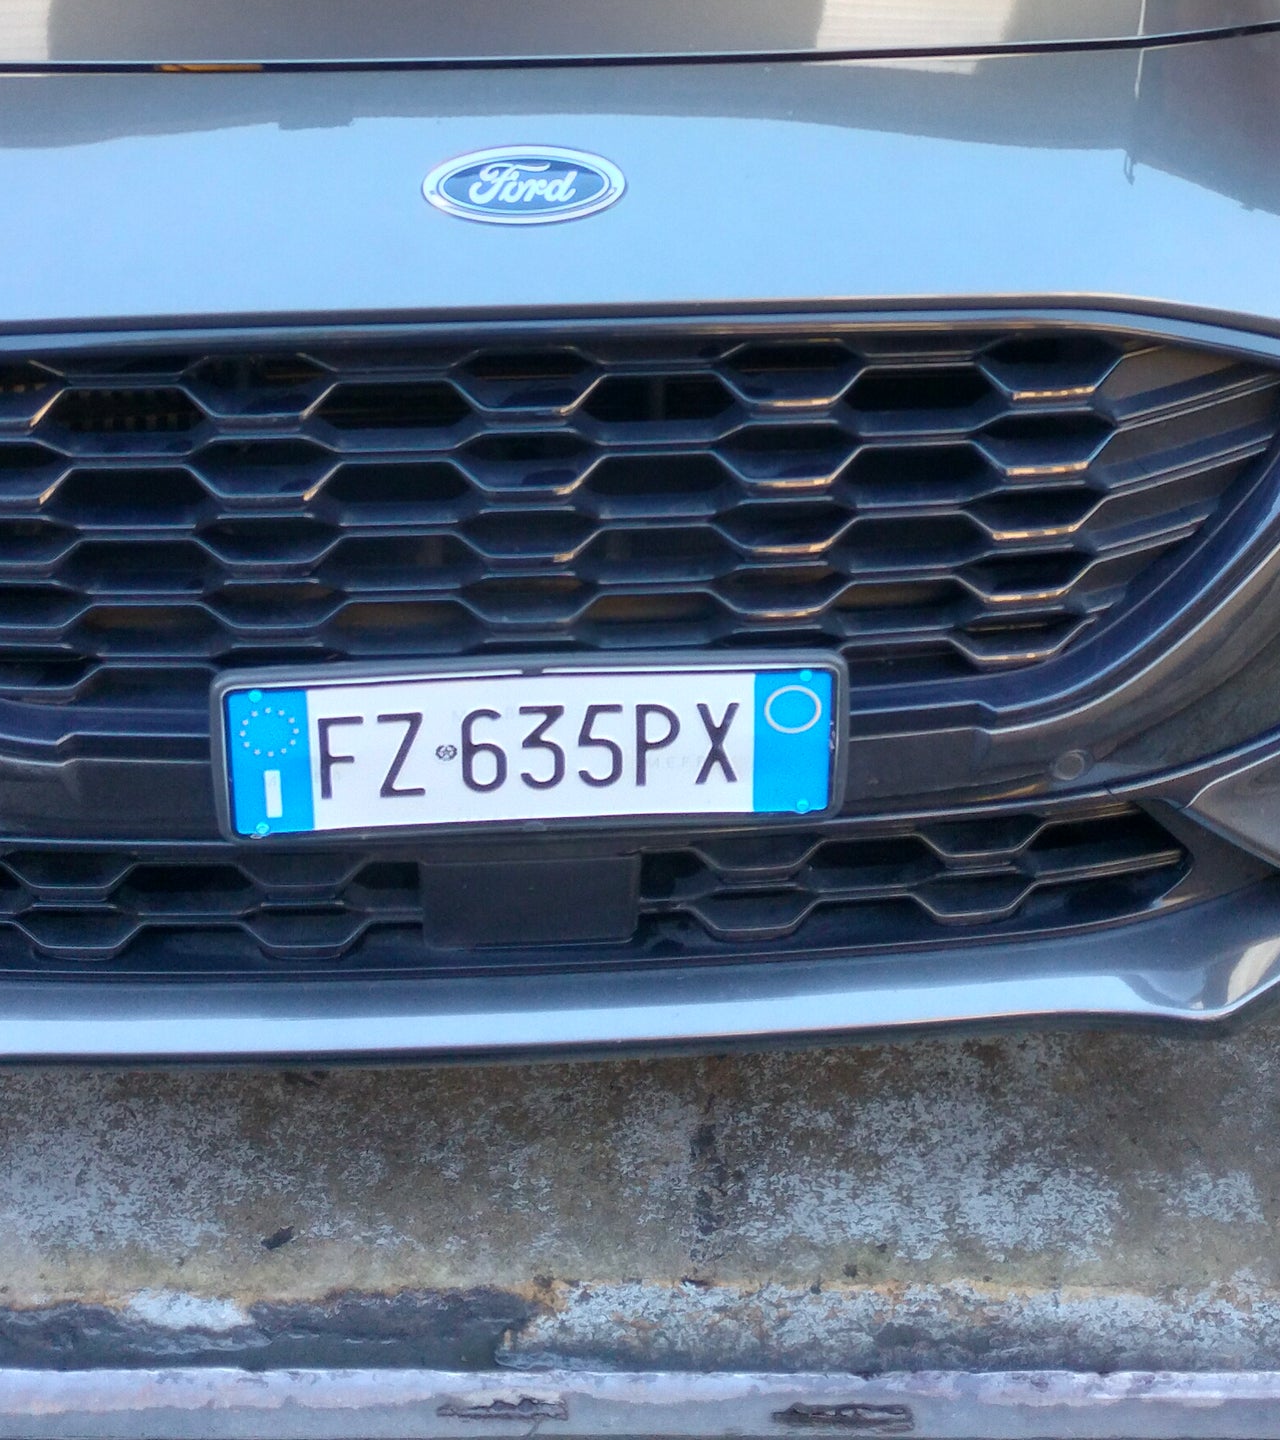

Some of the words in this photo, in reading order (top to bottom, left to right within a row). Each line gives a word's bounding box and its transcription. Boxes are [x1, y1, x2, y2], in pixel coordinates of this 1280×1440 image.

[469, 162, 578, 205] Ford
[317, 711, 426, 800] FZ
[459, 702, 740, 794] 635PX
